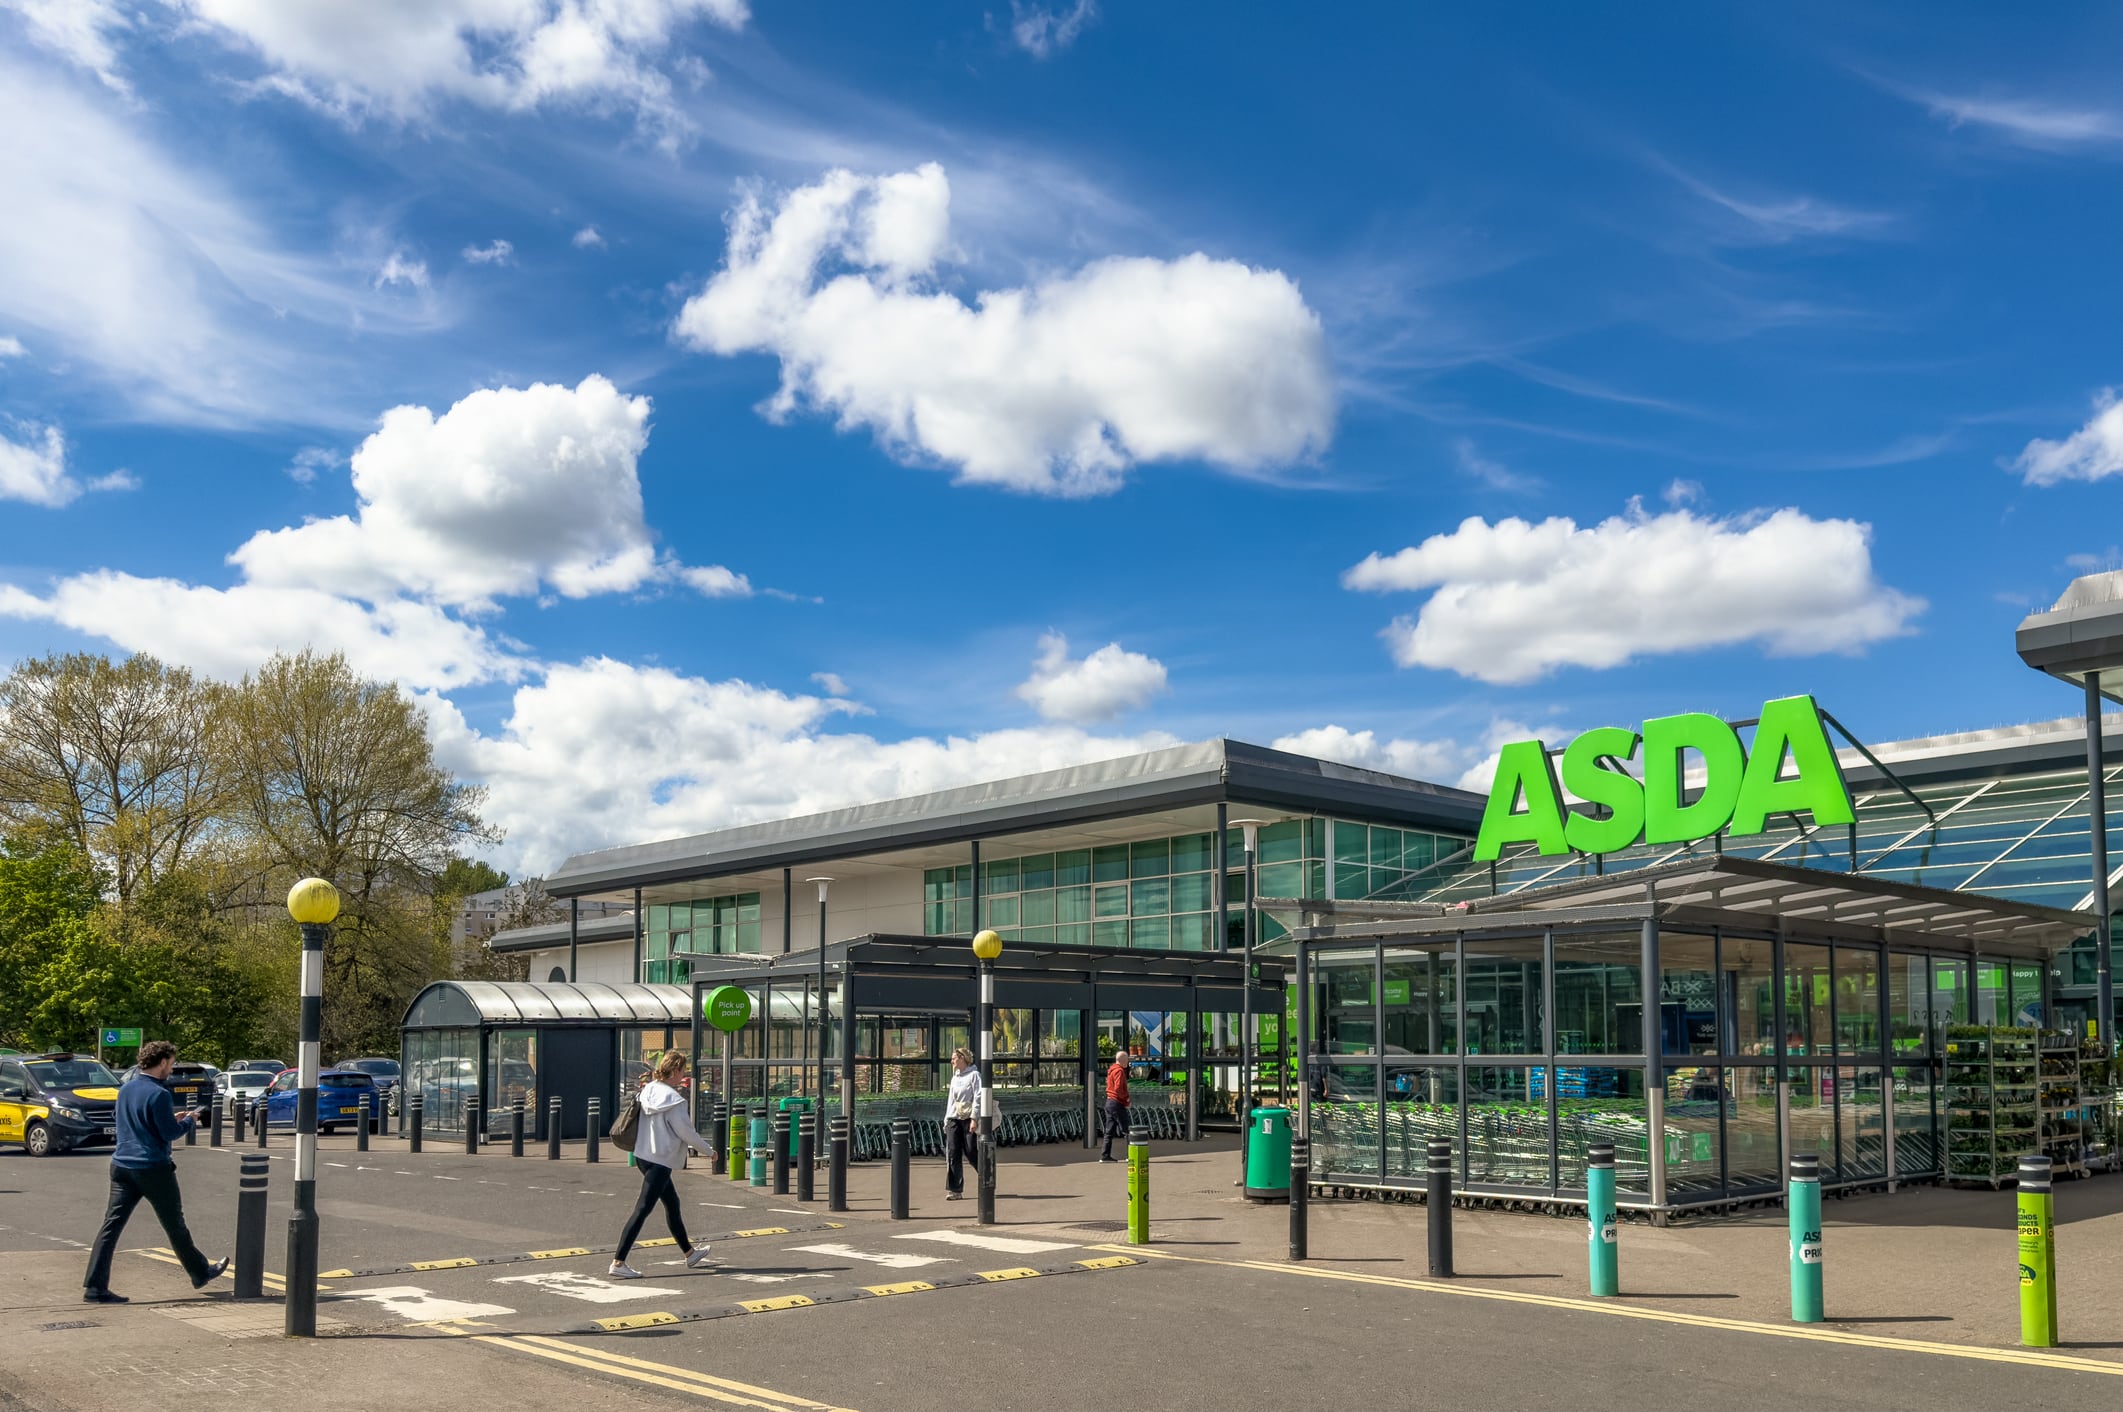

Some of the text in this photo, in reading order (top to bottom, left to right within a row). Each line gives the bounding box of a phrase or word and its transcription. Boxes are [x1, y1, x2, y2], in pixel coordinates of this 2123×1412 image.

[1472, 694, 1858, 862] ASDA
[718, 1001, 745, 1010] Pick up
[1264, 1023, 1279, 1035] yo
[0, 1114, 12, 1125] xis
[1604, 1213, 1617, 1223] AS
[1802, 1231, 1821, 1241] AS
